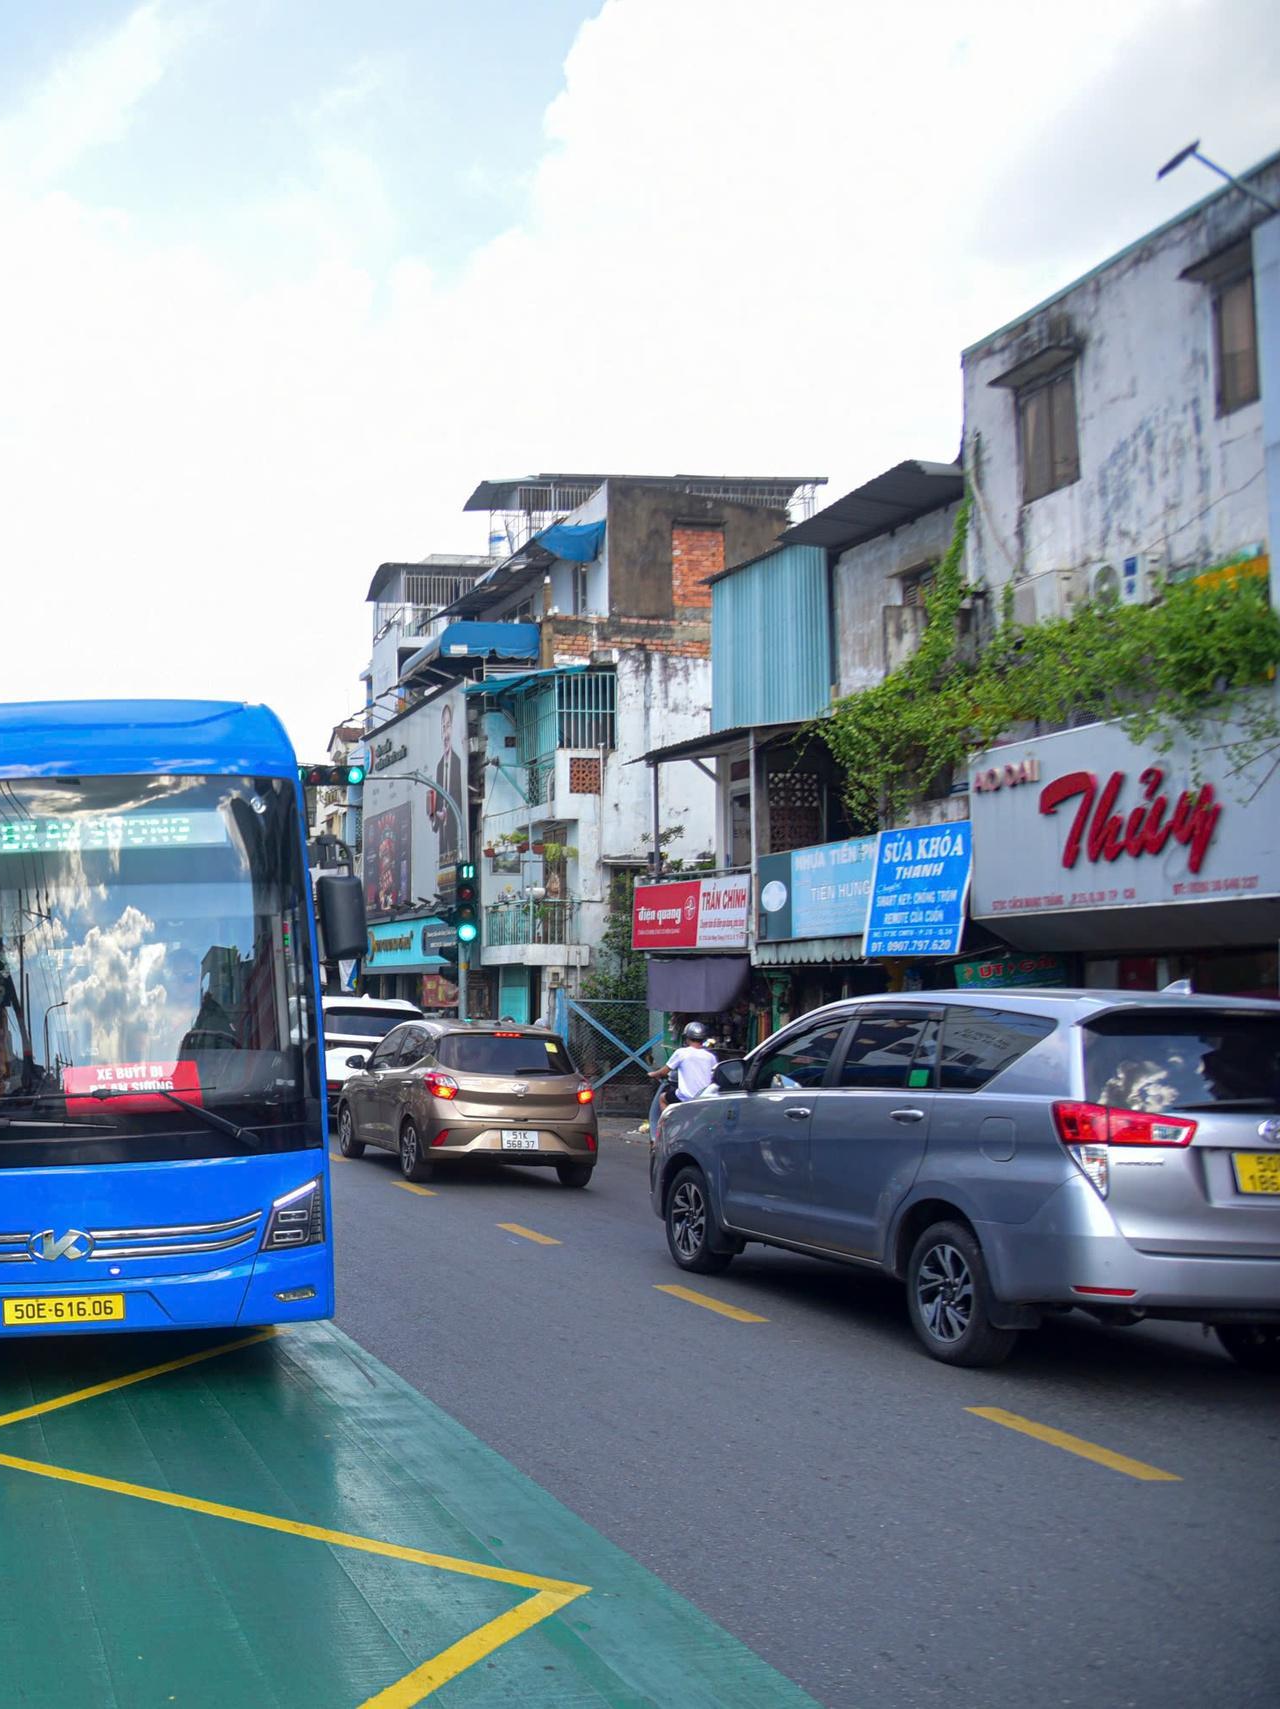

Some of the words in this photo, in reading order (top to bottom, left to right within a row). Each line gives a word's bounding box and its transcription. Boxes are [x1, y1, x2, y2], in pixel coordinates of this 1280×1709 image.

[1039, 767, 1222, 875] Thủy
[883, 832, 913, 864] SỬA
[916, 829, 964, 860] KHÓA
[657, 908, 682, 926] quang
[96, 1067, 113, 1081] XE
[512, 1131, 529, 1140] 51K
[14, 1300, 114, 1320] 50E-616.06
